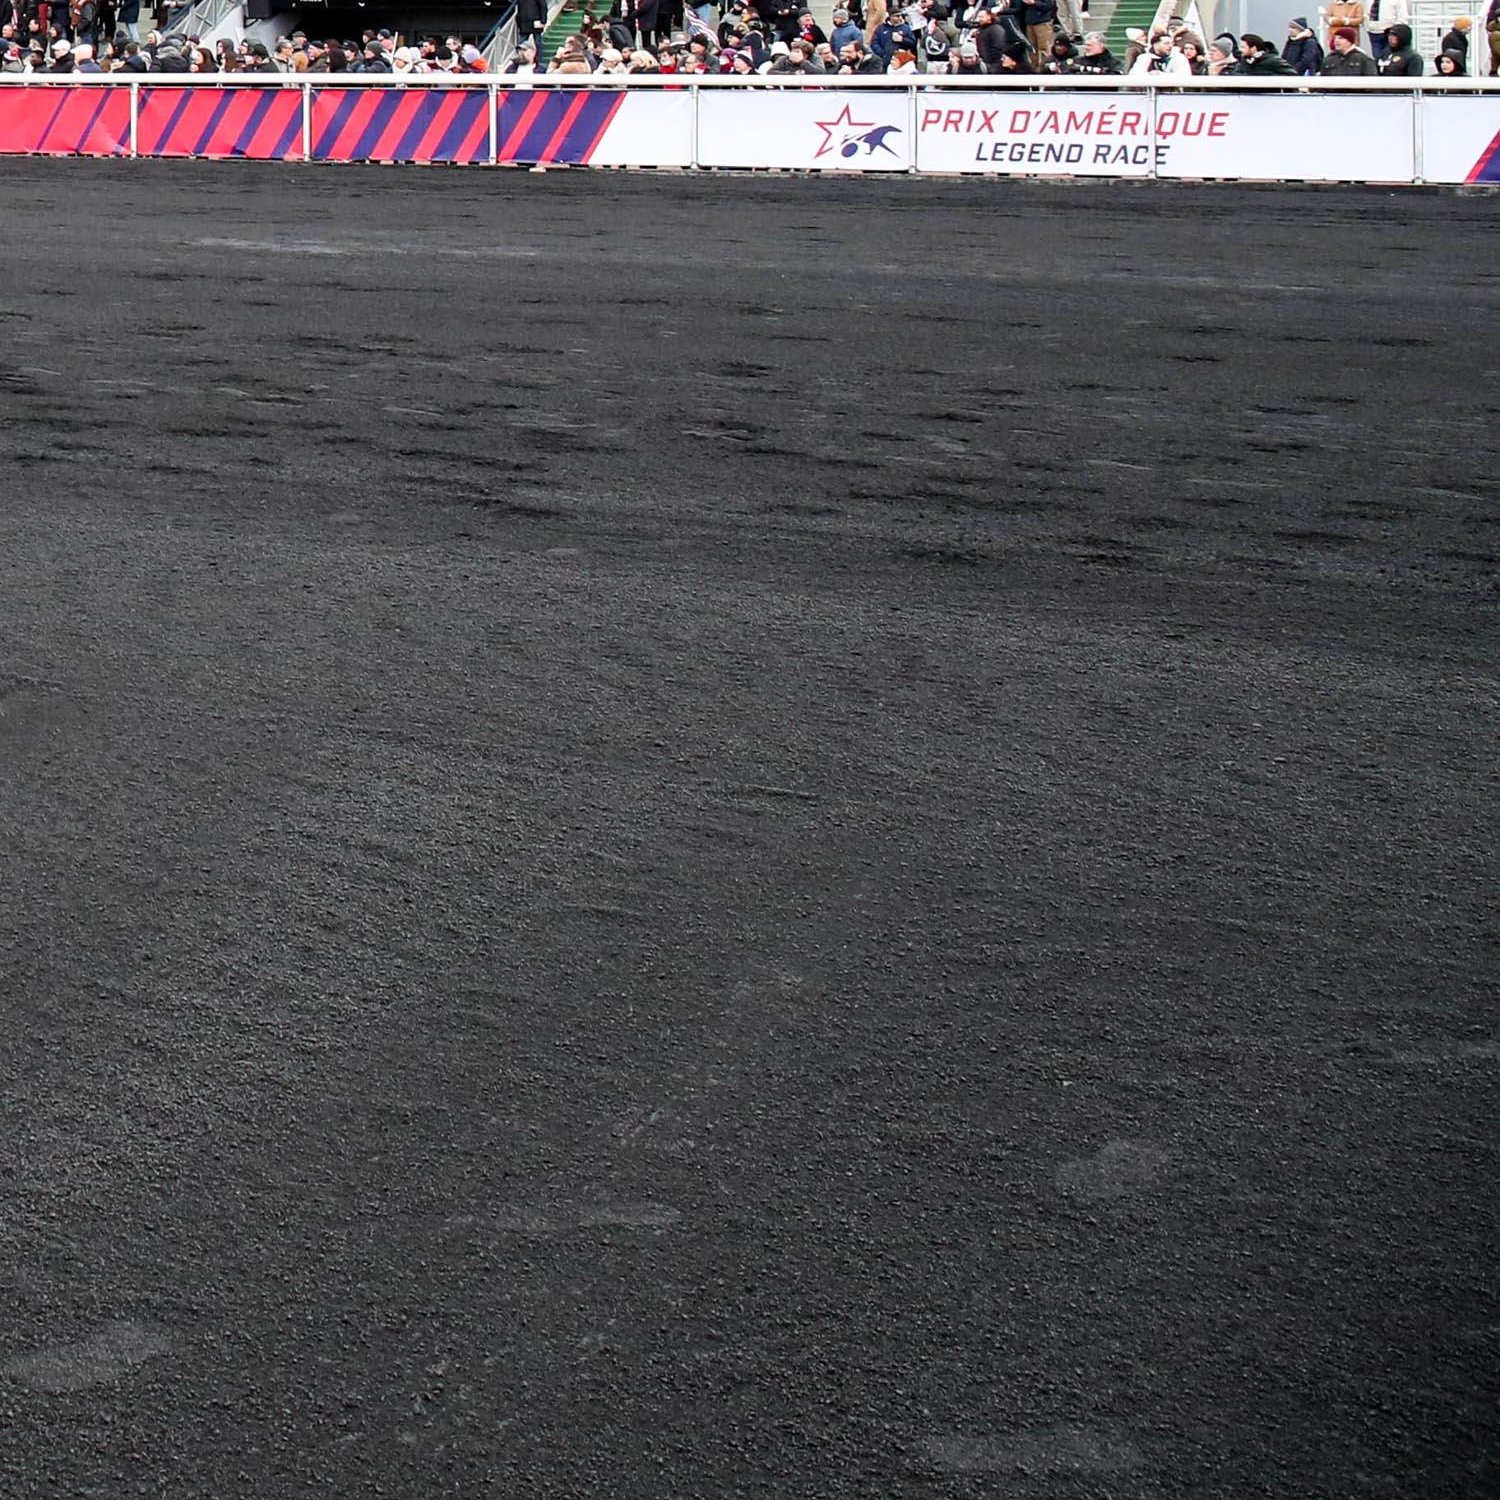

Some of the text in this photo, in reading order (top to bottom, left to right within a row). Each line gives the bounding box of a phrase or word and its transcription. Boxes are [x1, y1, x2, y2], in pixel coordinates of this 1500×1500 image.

[920, 104, 1230, 140] PRIX D'AMÉRIQUE
[975, 142, 1170, 165] LEGEND RACE
